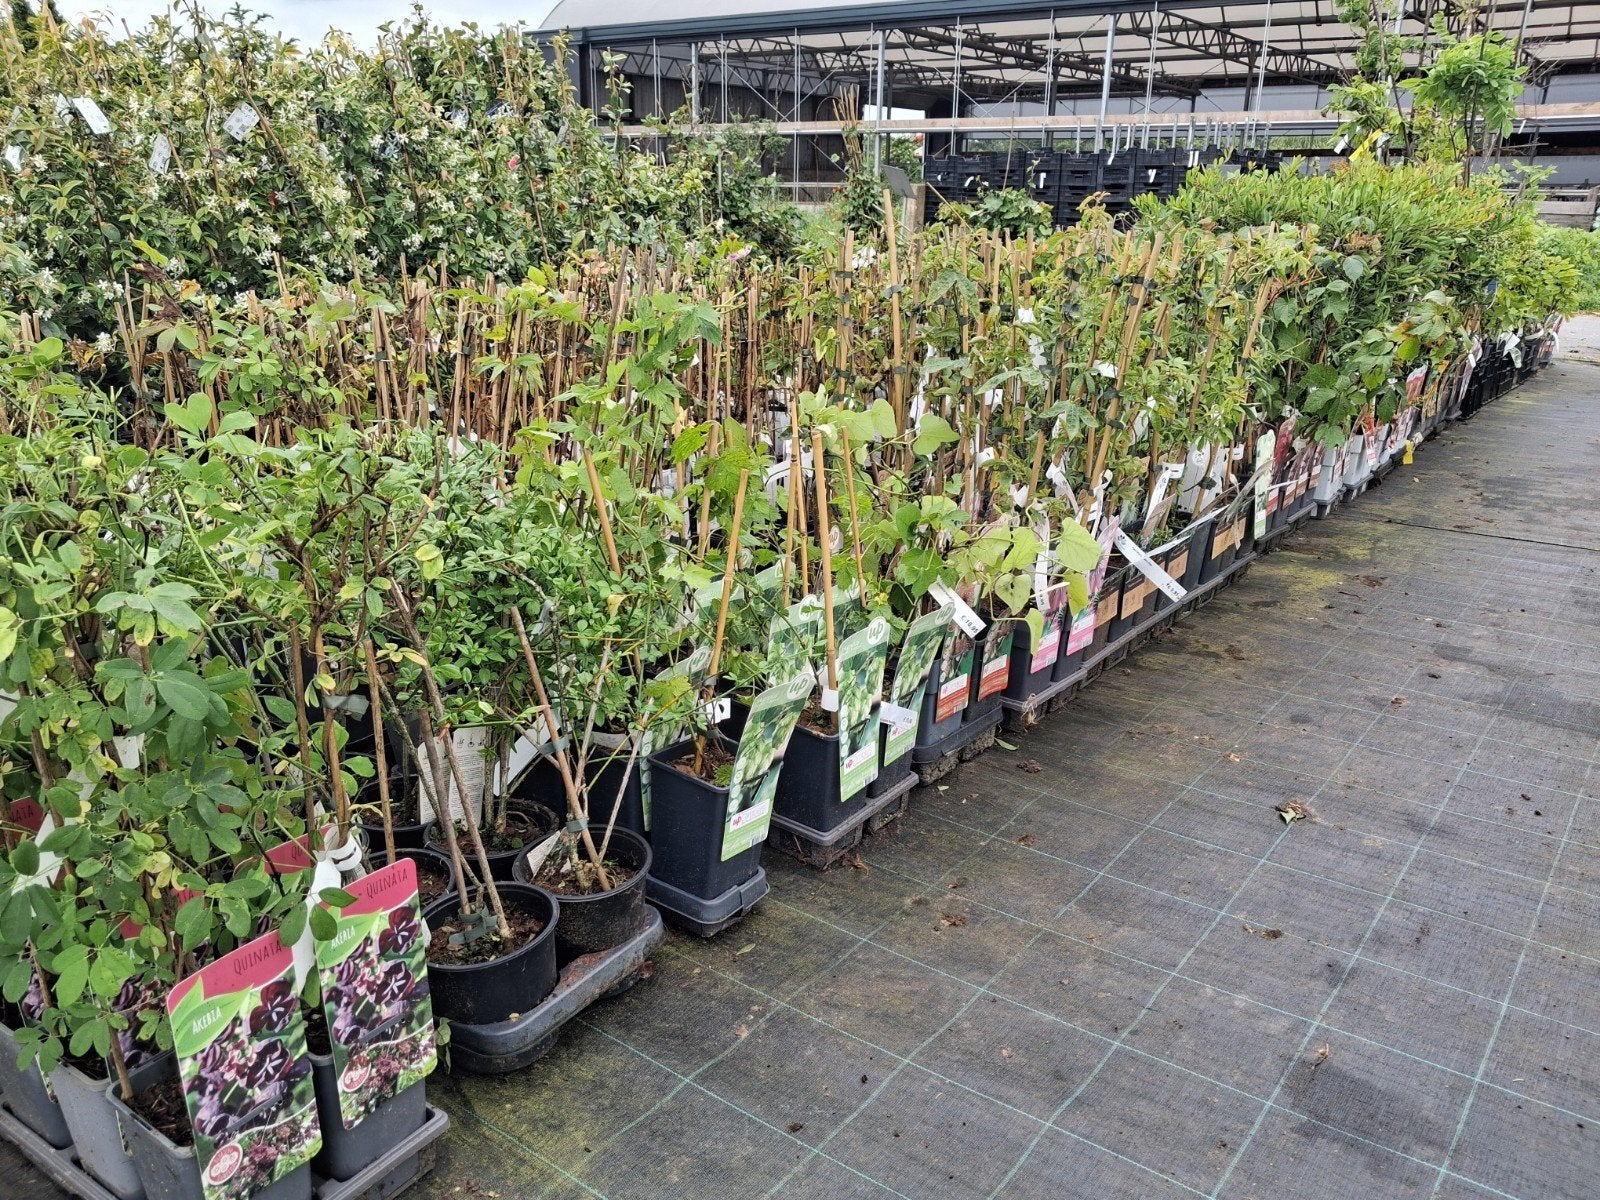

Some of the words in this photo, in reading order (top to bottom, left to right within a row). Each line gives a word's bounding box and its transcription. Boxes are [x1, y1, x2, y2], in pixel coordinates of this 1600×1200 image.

[868, 621, 884, 641] up
[789, 679, 809, 695] up
[366, 868, 408, 899] QUINATA
[233, 939, 282, 975] QUINATA
[192, 1006, 223, 1035] AKEBIA
